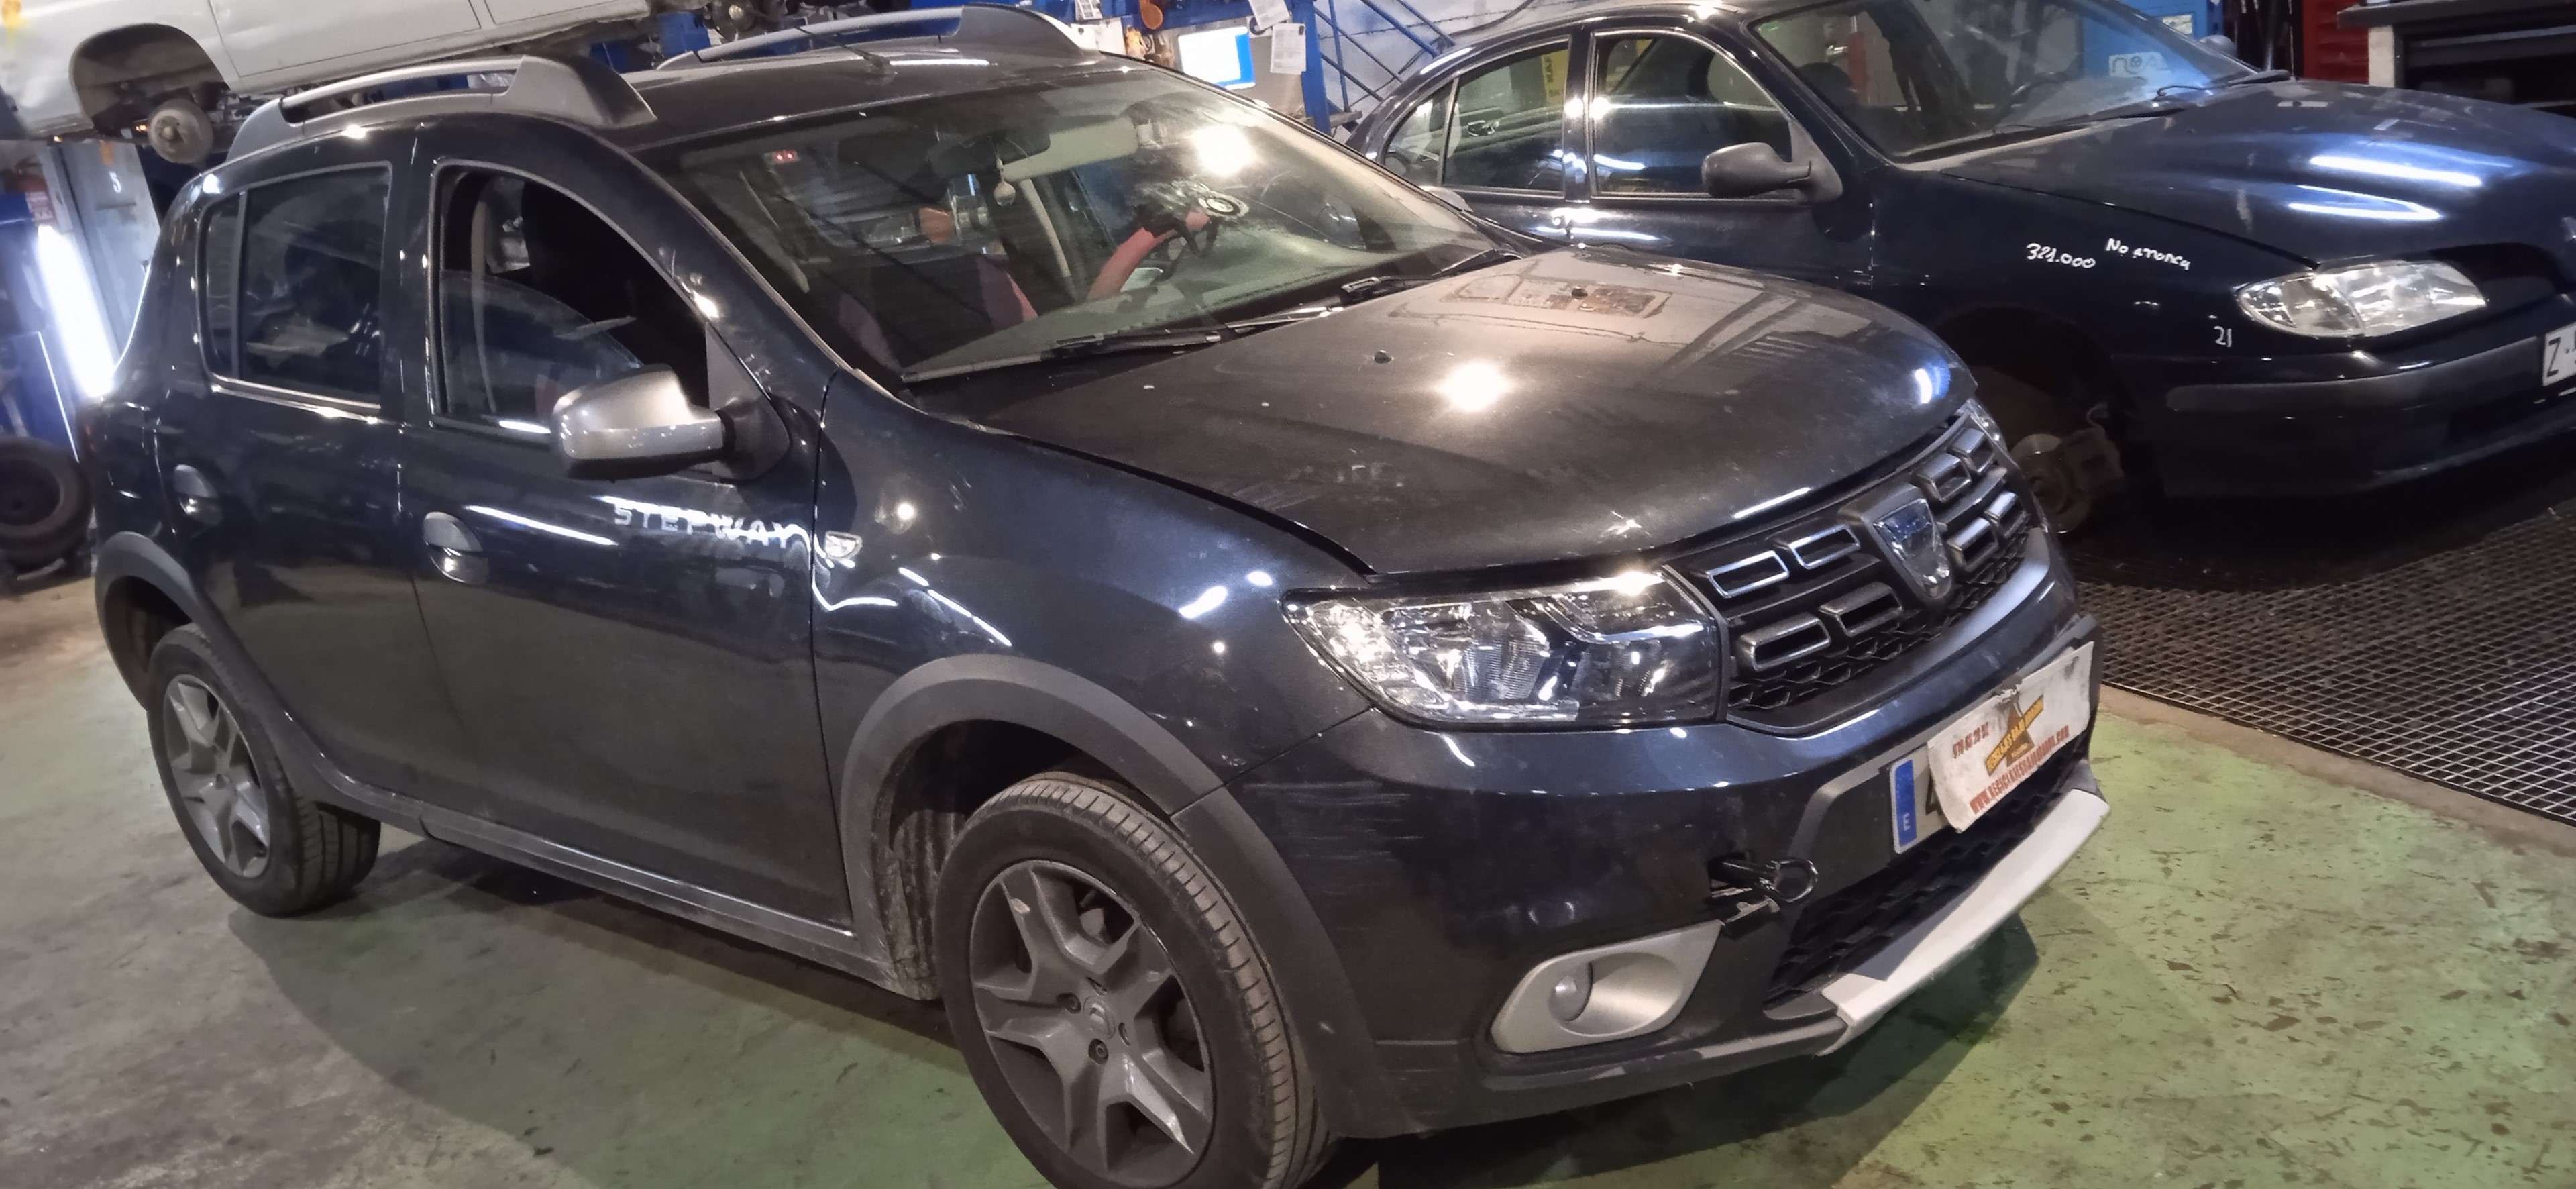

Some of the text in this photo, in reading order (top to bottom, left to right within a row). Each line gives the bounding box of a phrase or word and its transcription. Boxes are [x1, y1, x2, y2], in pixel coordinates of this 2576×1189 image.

[109, 171, 122, 194] 5
[2027, 243, 2096, 268] 321.000
[2214, 325, 2232, 347] 21
[613, 499, 790, 549] STEPWAY
[1903, 813, 1911, 831] E
